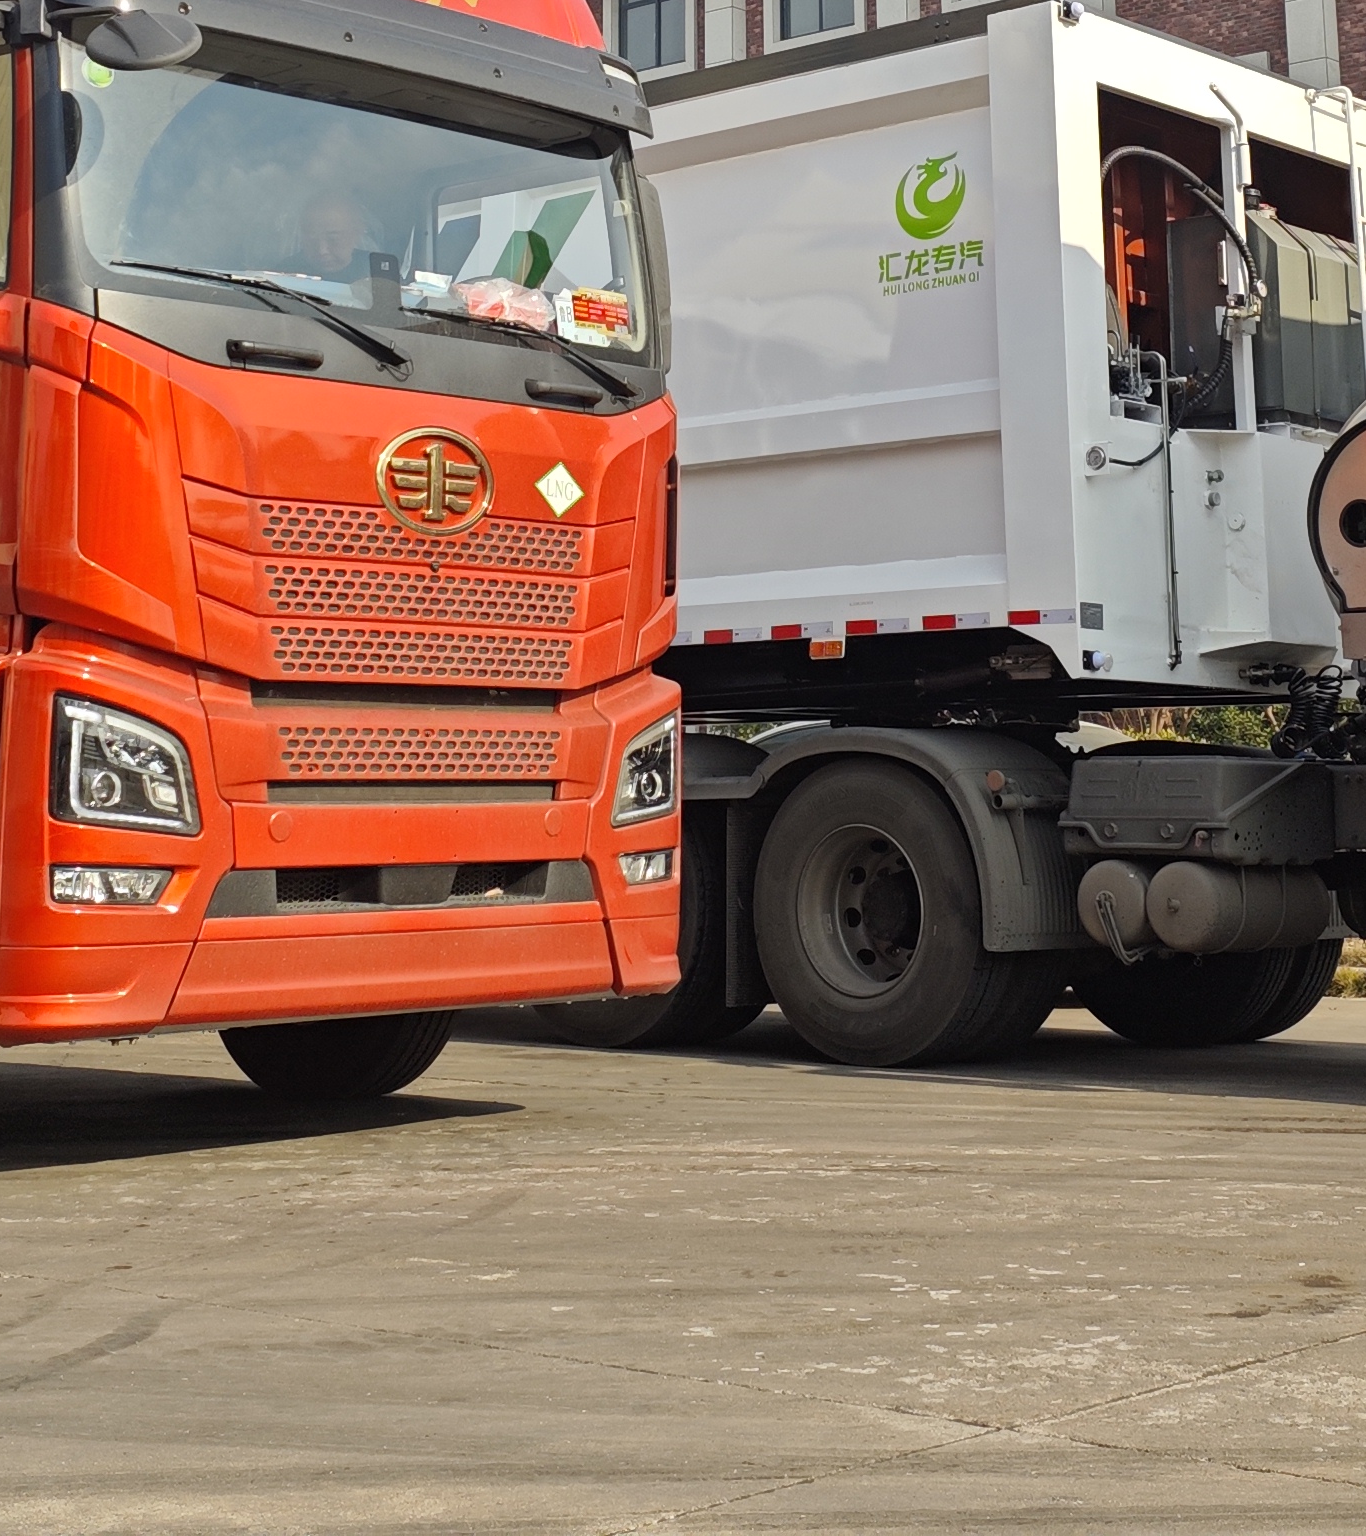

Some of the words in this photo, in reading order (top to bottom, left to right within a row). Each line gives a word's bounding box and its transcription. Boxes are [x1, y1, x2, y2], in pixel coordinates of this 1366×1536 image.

[878, 240, 984, 283] 汇龙专汽
[883, 285, 901, 296] HUI
[903, 279, 930, 294] LONG
[932, 273, 966, 289] ZHUAN
[968, 271, 980, 283] QI
[546, 478, 574, 501] LNG
